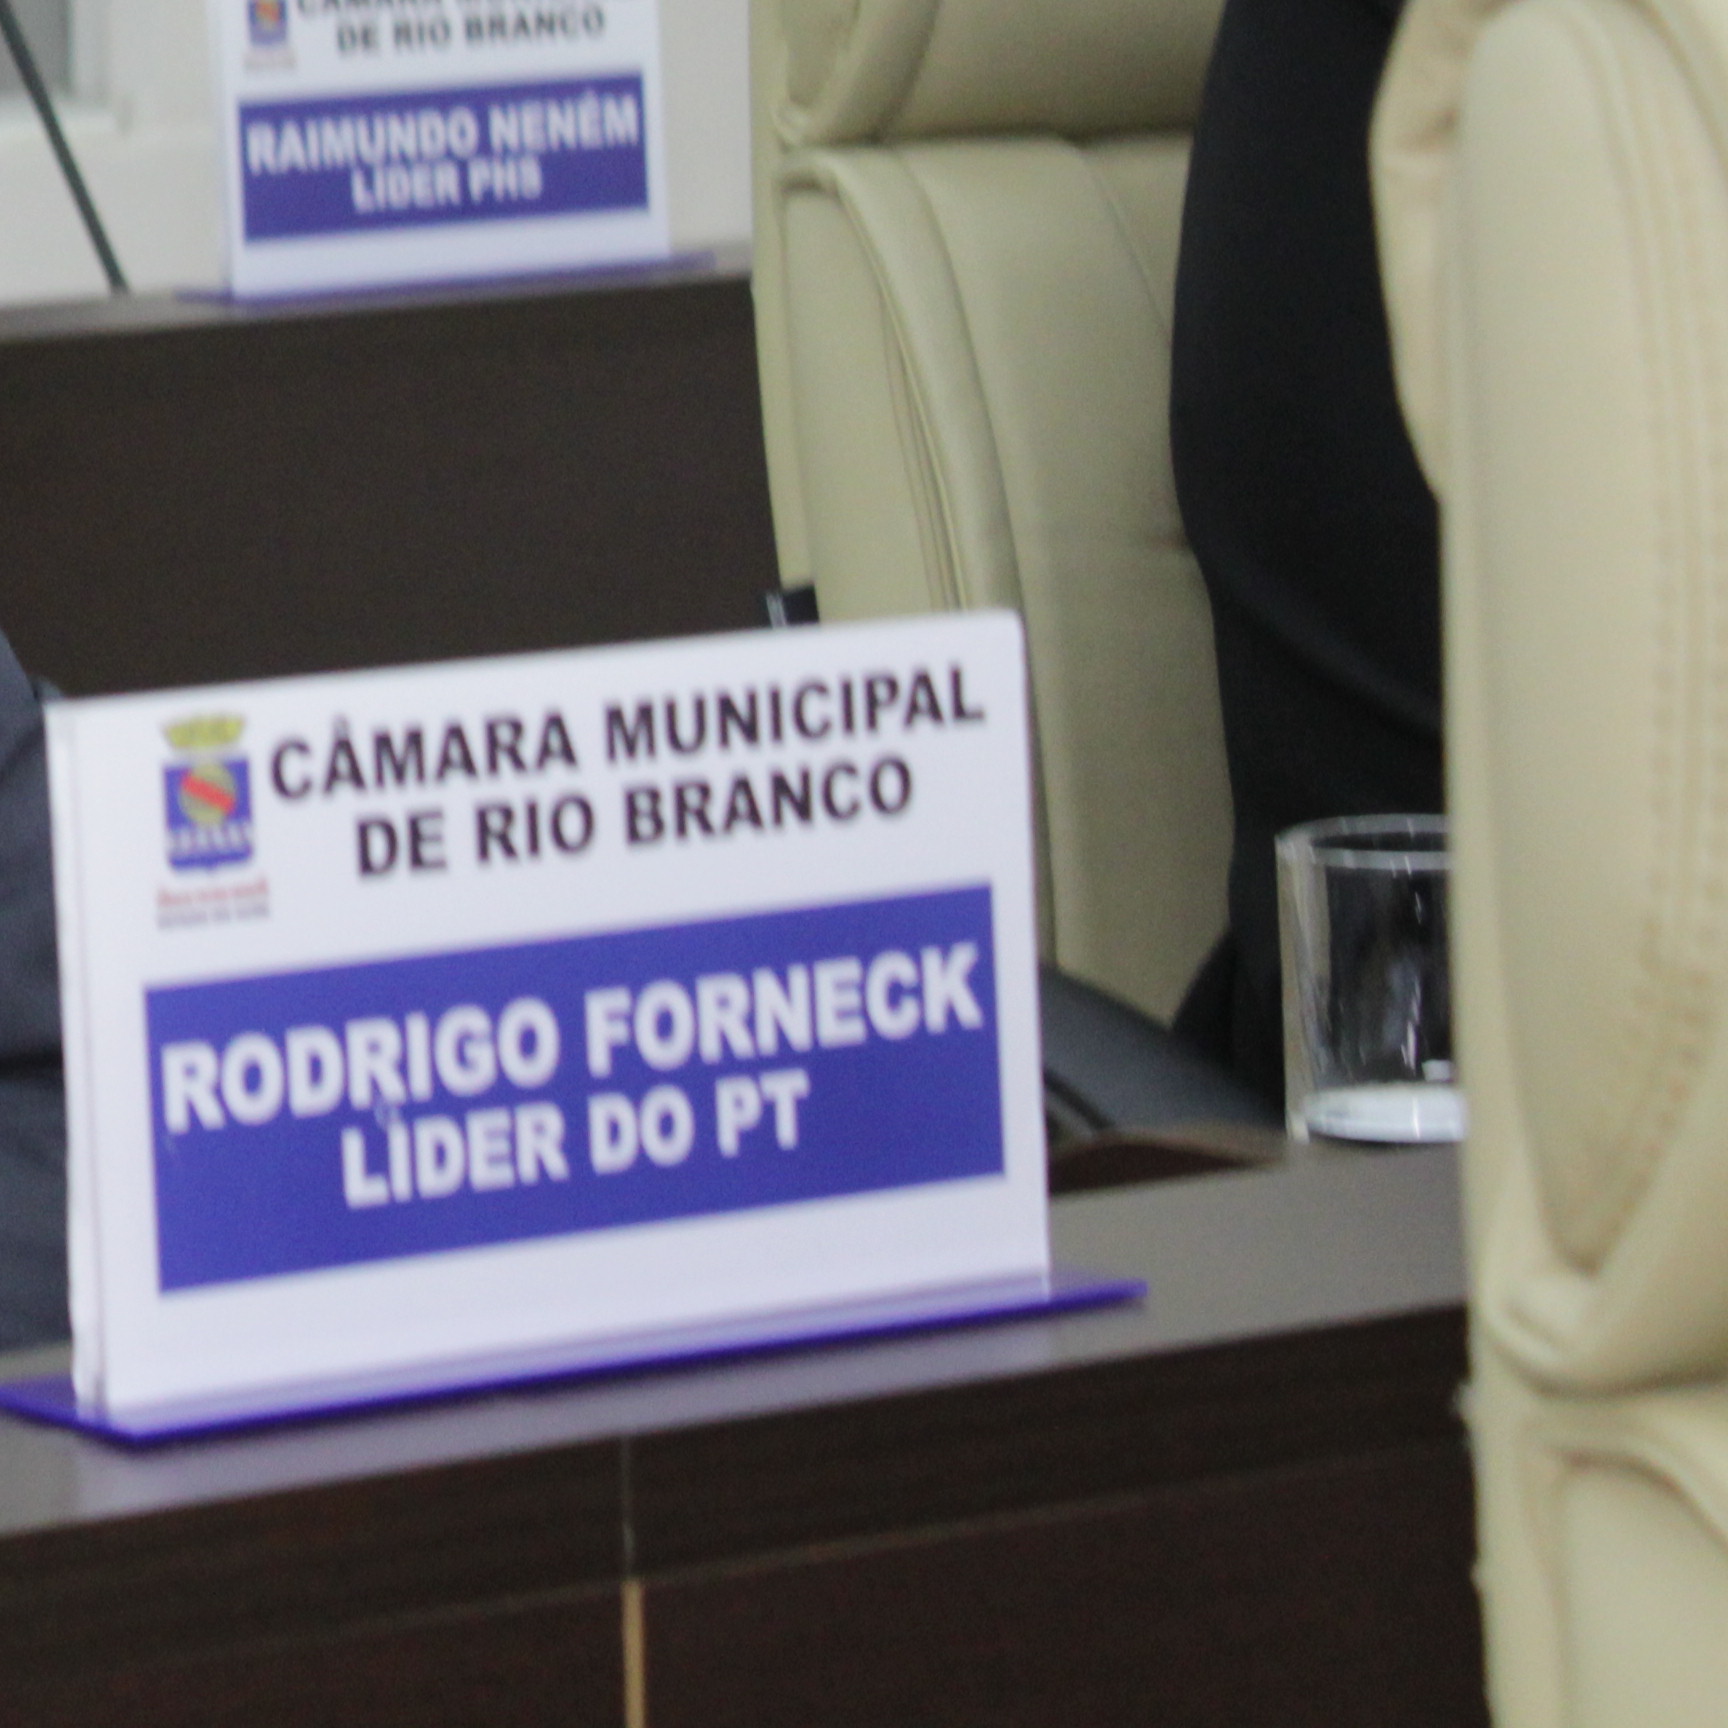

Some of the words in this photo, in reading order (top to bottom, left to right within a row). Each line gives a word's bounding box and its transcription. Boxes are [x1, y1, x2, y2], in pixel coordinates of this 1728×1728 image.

[337, 20, 378, 53] DE
[393, 16, 451, 49] RIO
[465, 4, 605, 45] BRANCO
[247, 105, 479, 174] RAIMUNDO
[271, 712, 575, 801] CÂMARA
[605, 663, 984, 762] MUNICIPAL
[357, 807, 447, 877] DE
[475, 794, 594, 862] RIO
[625, 756, 914, 847] BRANCO
[160, 996, 558, 1135] RODRIGO
[584, 942, 983, 1075] FORNECK
[588, 1087, 694, 1175] DO
[715, 1071, 809, 1158] PT
